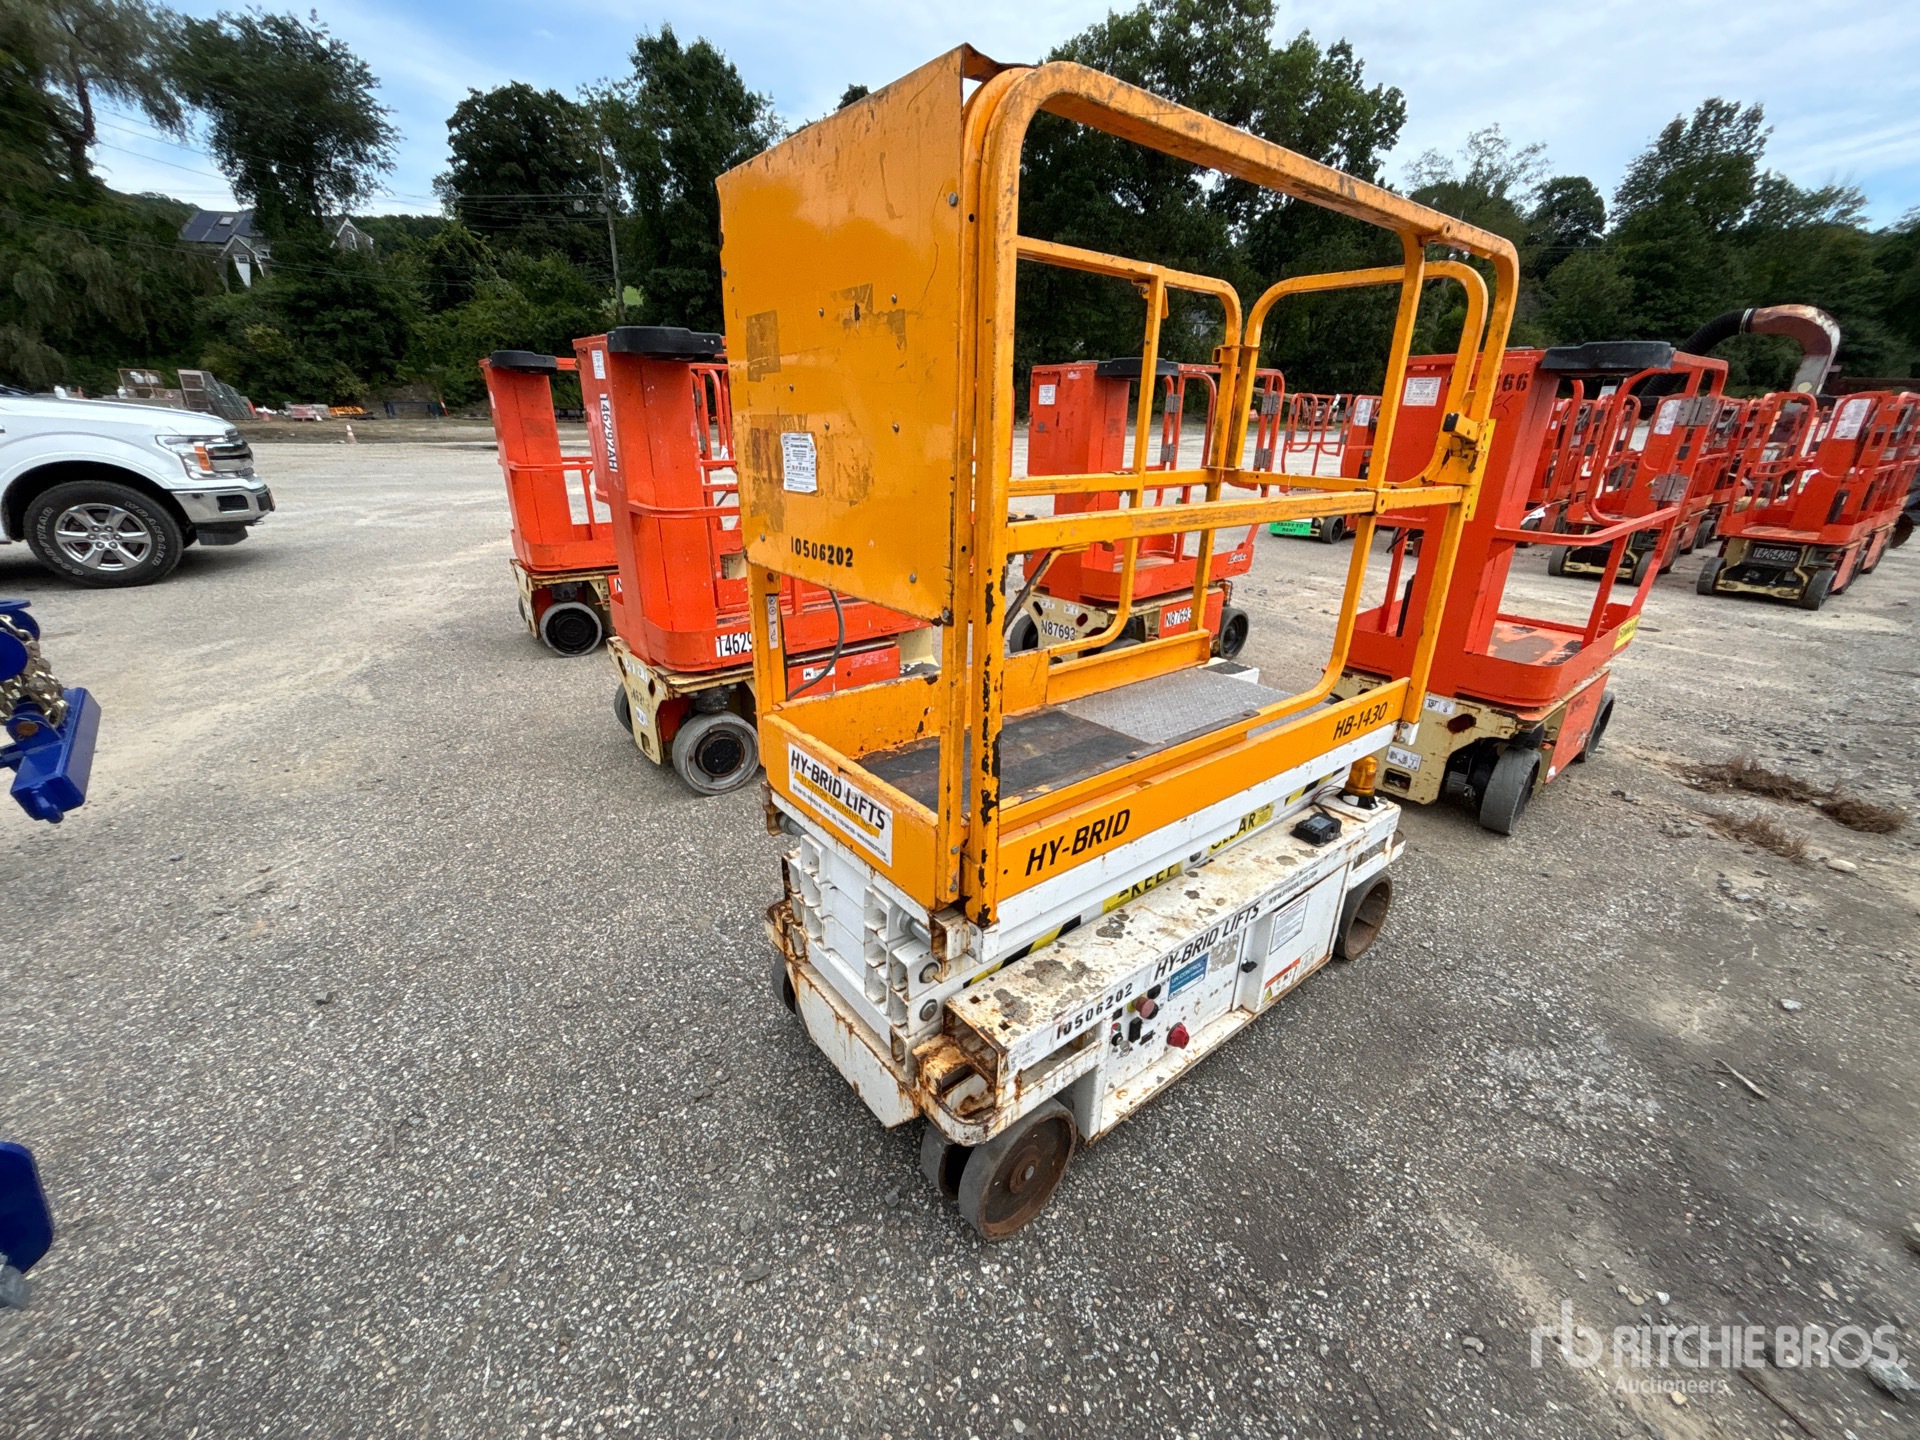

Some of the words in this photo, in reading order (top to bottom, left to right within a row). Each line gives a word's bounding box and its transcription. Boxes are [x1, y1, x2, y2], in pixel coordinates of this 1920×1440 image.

[791, 535, 853, 568] 10506202
[1041, 619, 1076, 641] N87693
[1333, 701, 1388, 741] HB-1430
[1025, 808, 1131, 877] HY-BRID
[1154, 927, 1220, 981] HY-BRID
[1222, 901, 1261, 938] LIFTS
[1057, 982, 1133, 1039] 10506202
